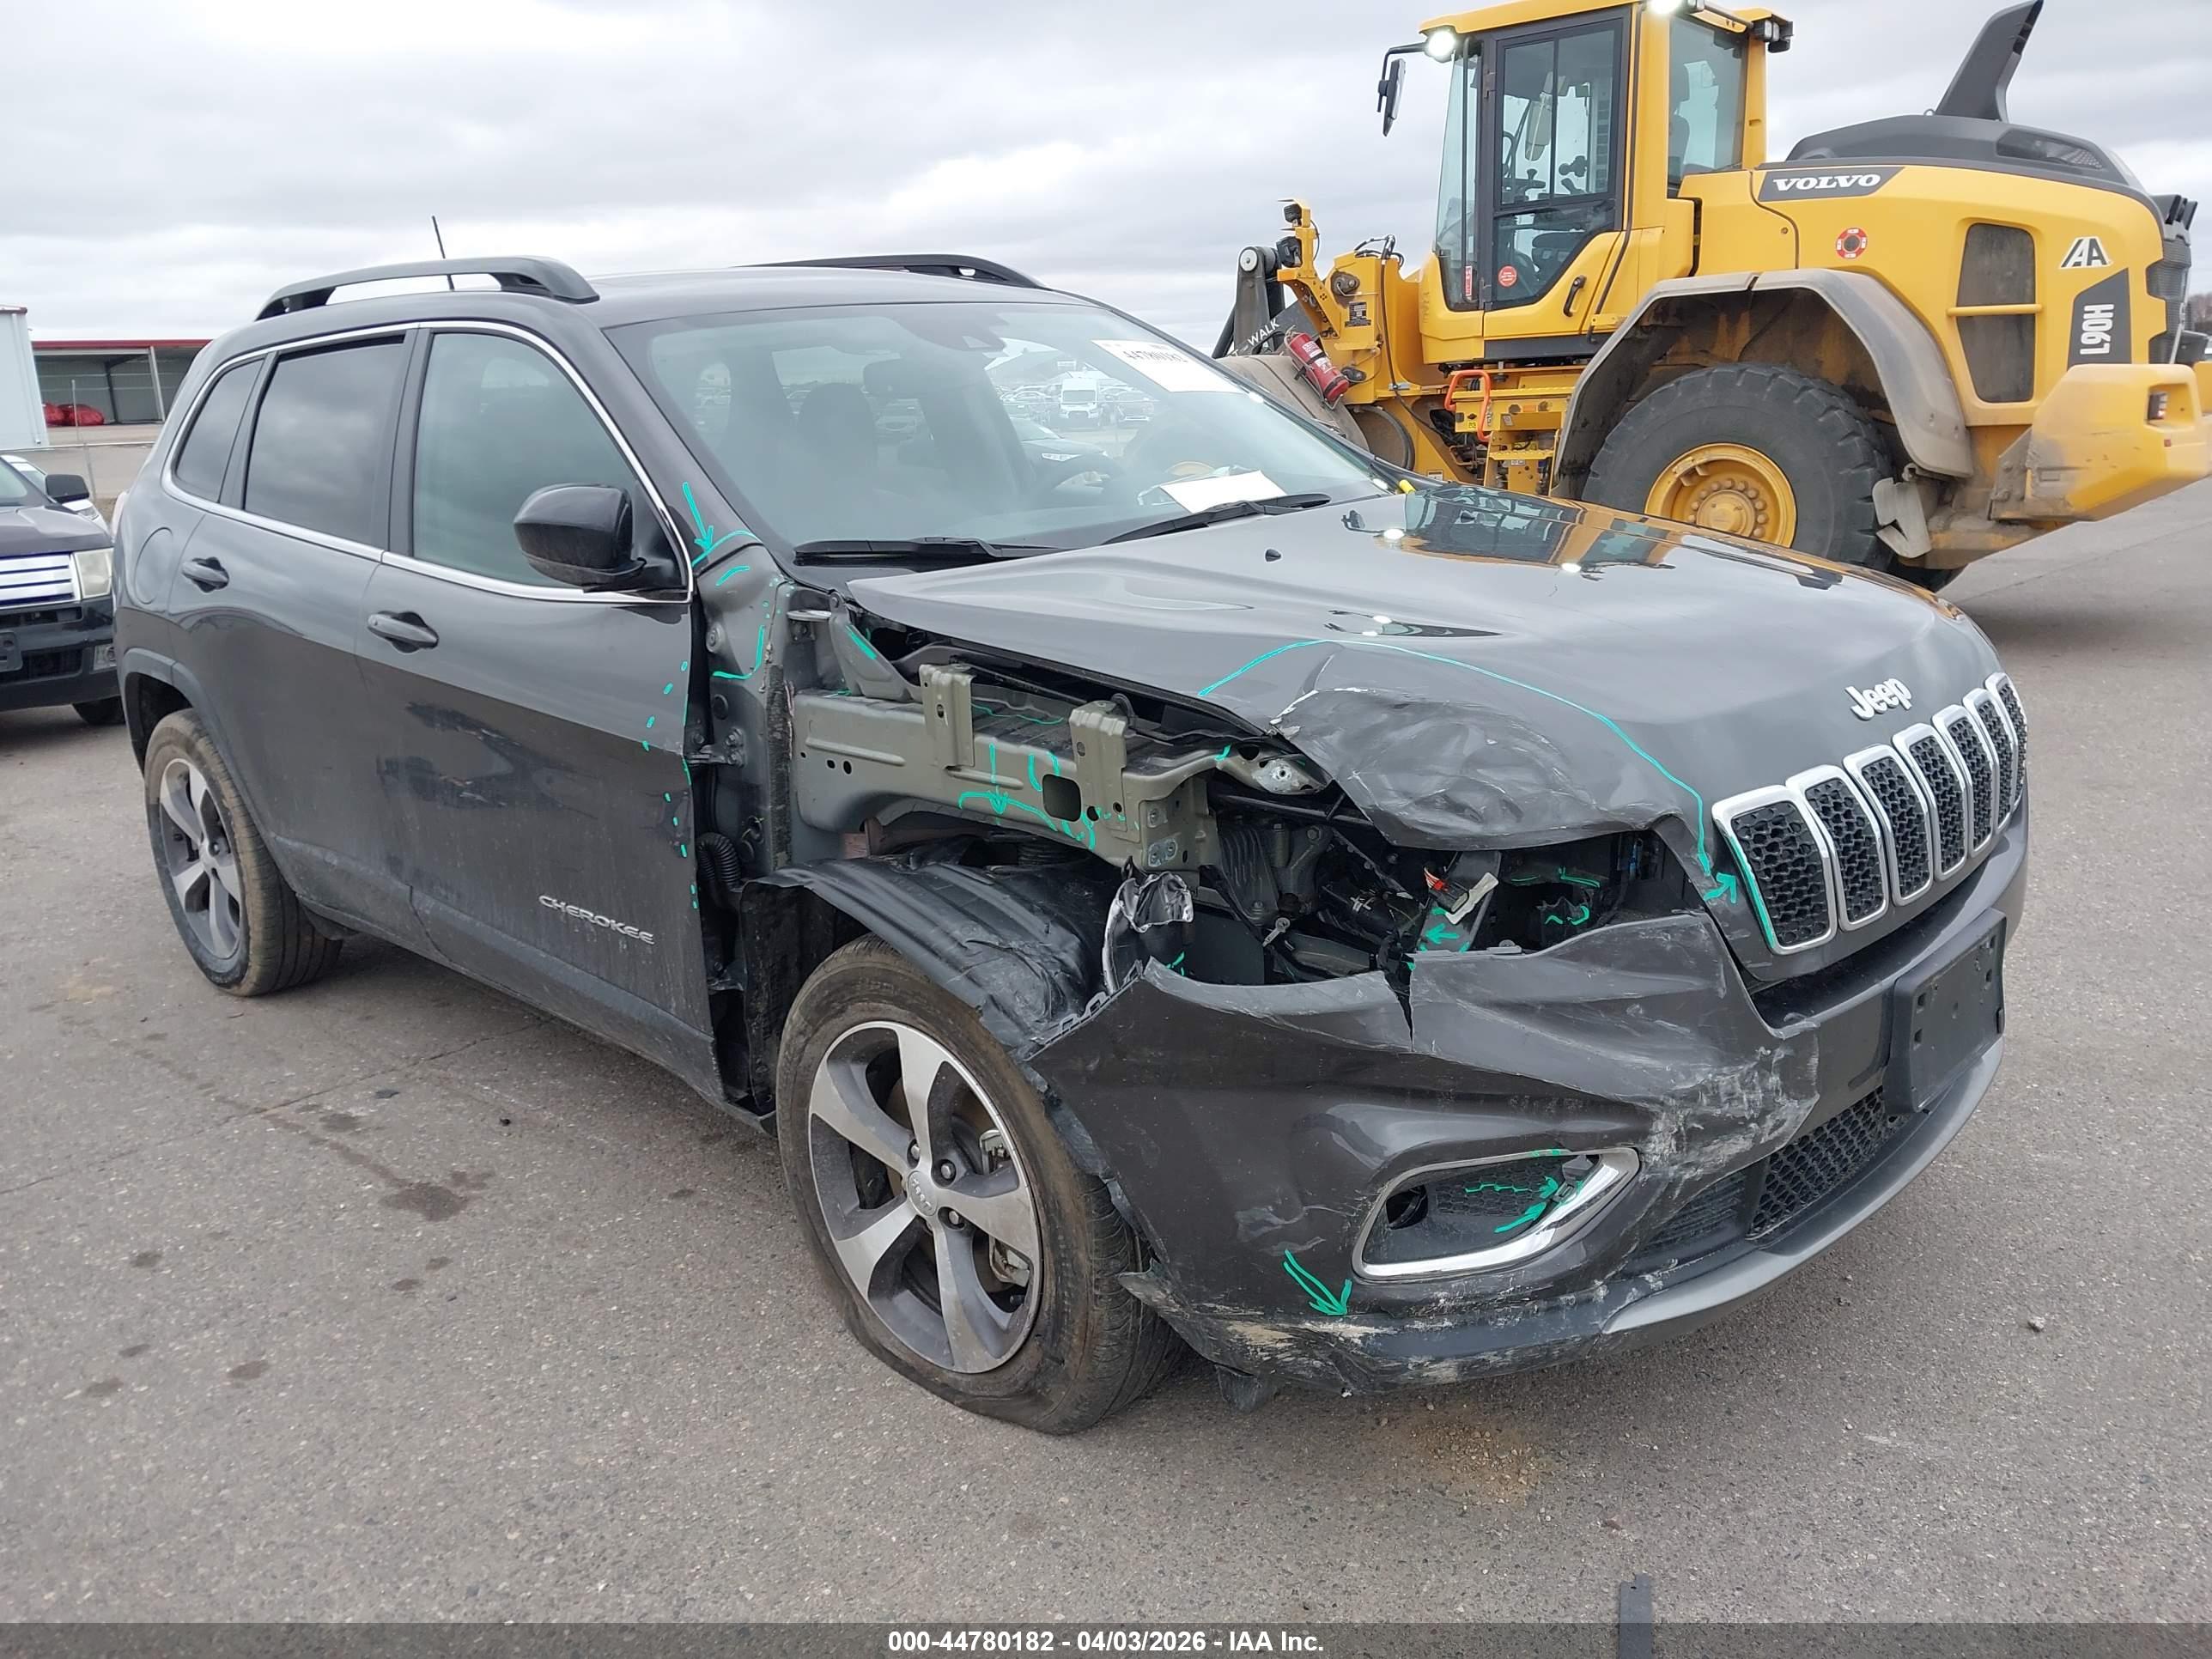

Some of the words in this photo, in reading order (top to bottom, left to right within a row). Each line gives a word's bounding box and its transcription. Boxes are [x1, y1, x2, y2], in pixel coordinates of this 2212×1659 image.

[1772, 173, 1881, 191] VOLVO
[1247, 319, 1280, 347] WALK
[2079, 303, 2115, 356] L90H
[1844, 678, 1913, 720] Jeep
[538, 894, 655, 945] CHEROKEE
